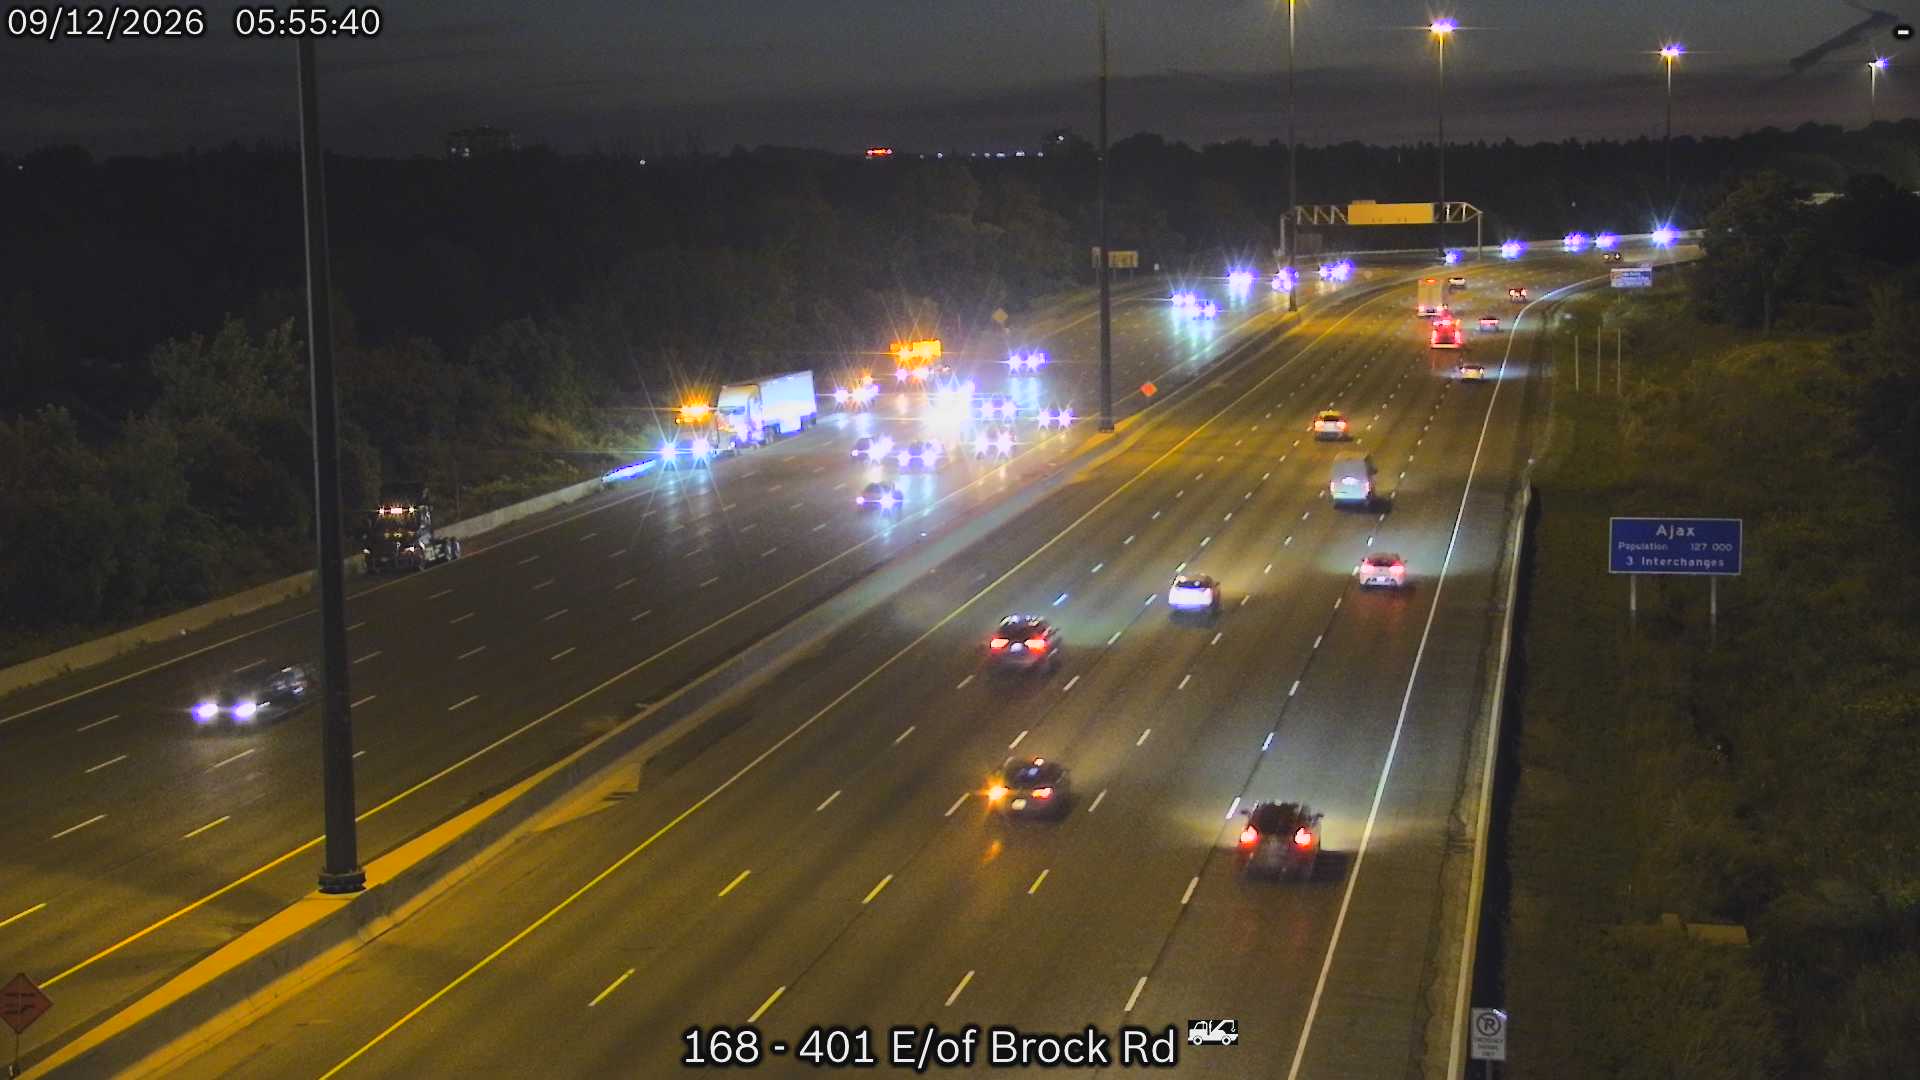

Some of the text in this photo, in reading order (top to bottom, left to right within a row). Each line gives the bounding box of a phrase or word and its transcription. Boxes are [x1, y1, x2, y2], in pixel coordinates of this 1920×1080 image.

[1656, 524, 1696, 540] Ajax
[1618, 541, 1733, 552] Population 127 000
[1626, 556, 1725, 569] 3 Interchanges
